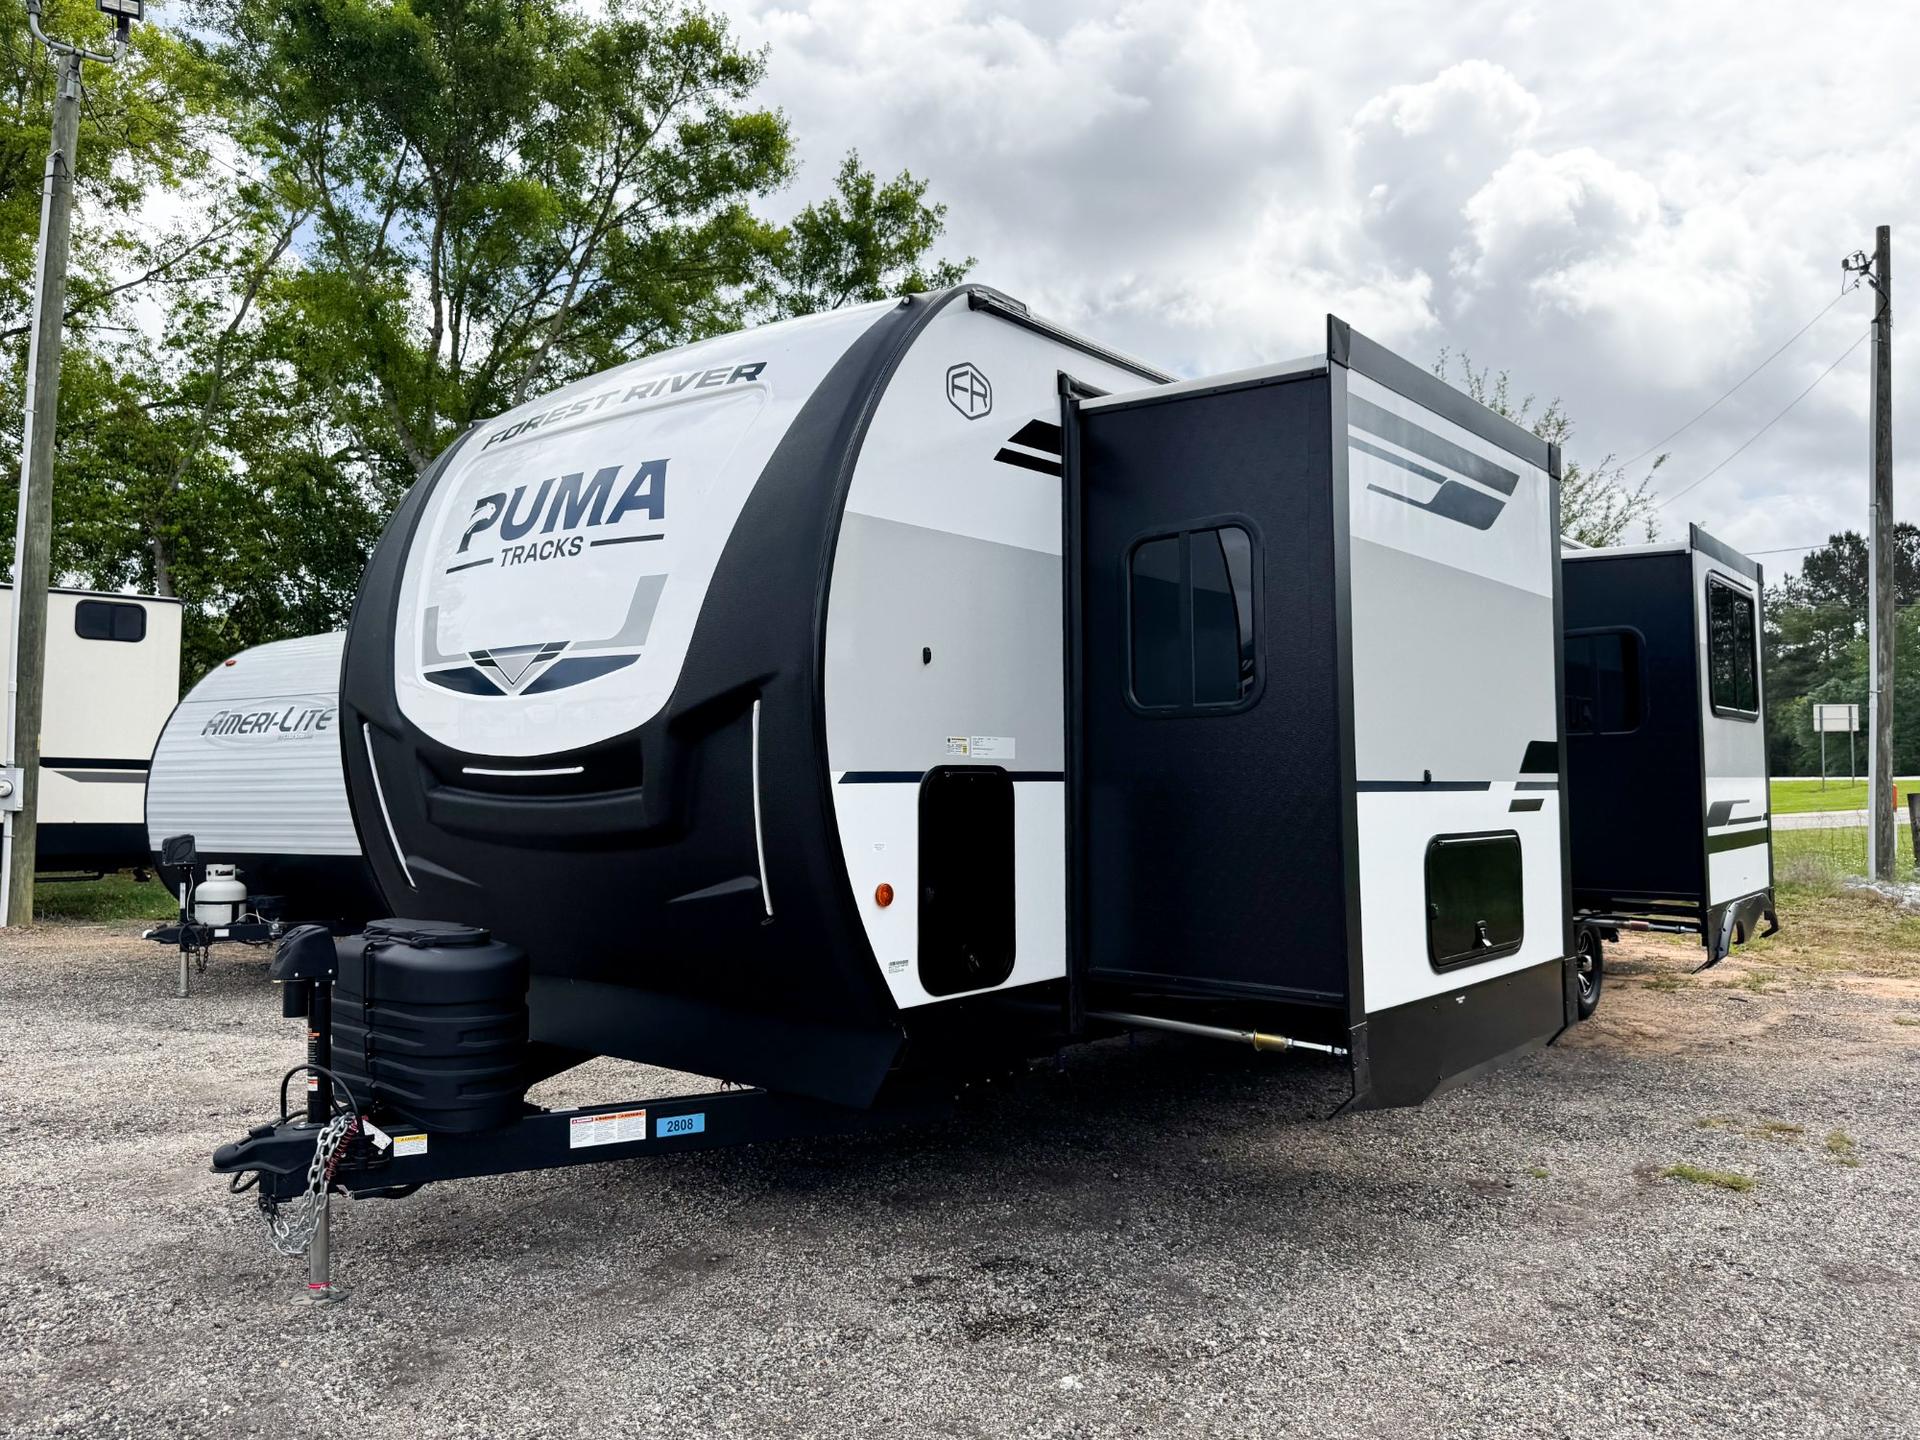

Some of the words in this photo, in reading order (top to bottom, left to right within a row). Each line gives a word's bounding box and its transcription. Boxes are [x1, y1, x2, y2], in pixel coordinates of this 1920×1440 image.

[481, 389, 620, 451] FOREST
[621, 361, 768, 403] RIVER
[456, 457, 670, 554] PUMA
[500, 535, 584, 567] TRACKS
[666, 1118, 694, 1133] 2808
